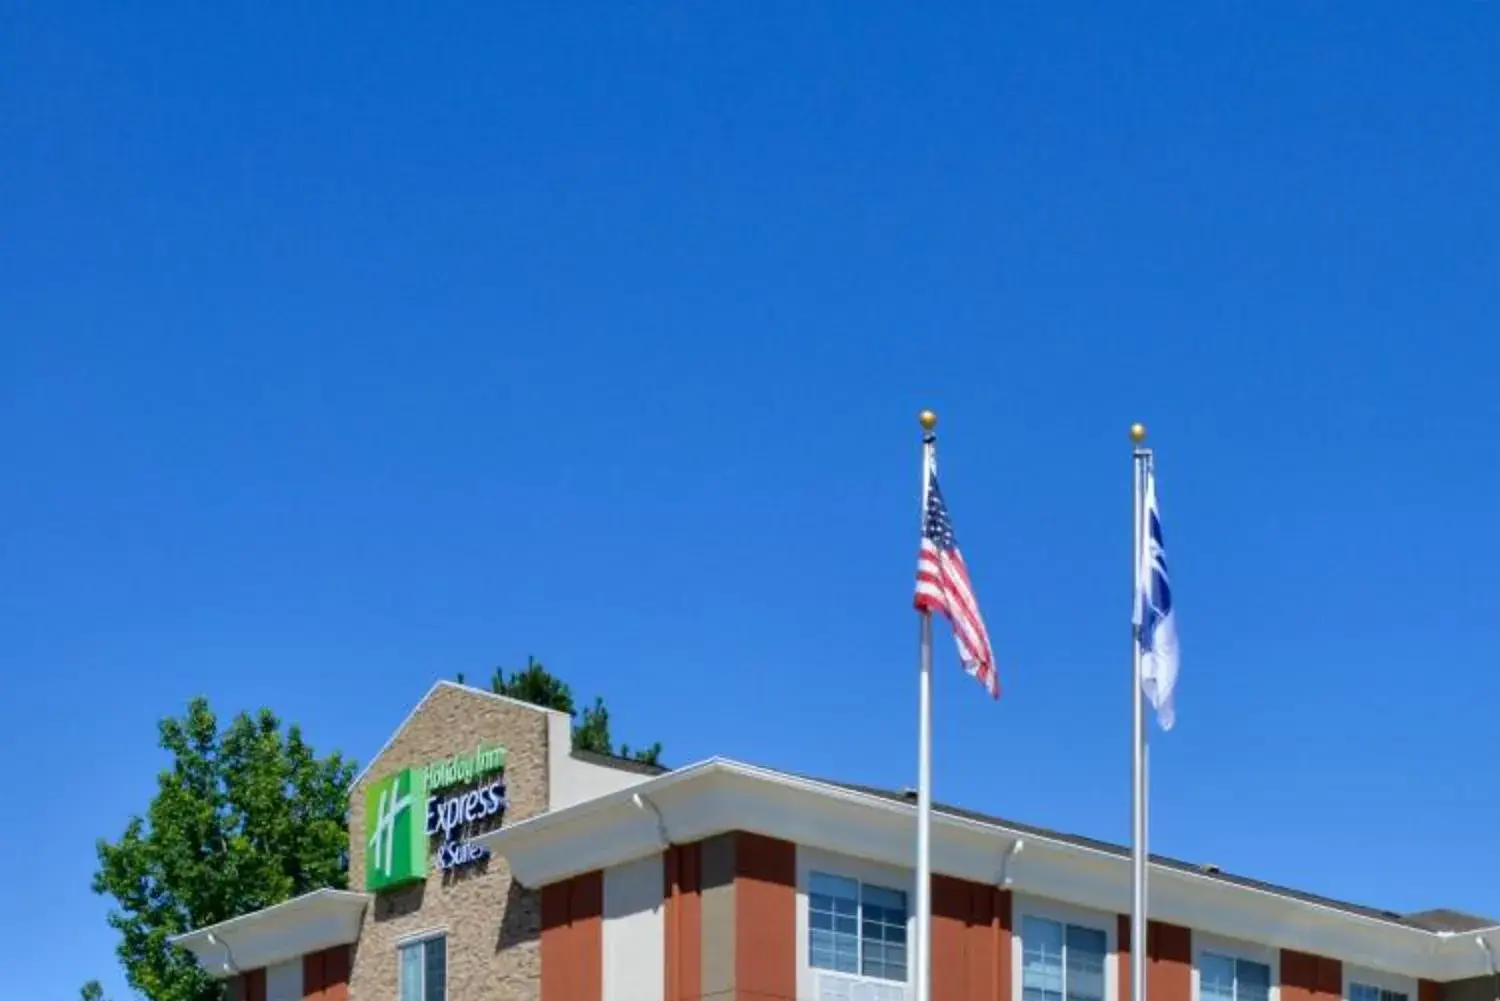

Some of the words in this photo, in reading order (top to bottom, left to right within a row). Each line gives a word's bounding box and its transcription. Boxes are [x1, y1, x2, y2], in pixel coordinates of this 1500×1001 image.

[424, 754, 475, 791] Holiday
[476, 740, 507, 774] Inn
[424, 780, 503, 840] Express
[435, 845, 447, 870] &
